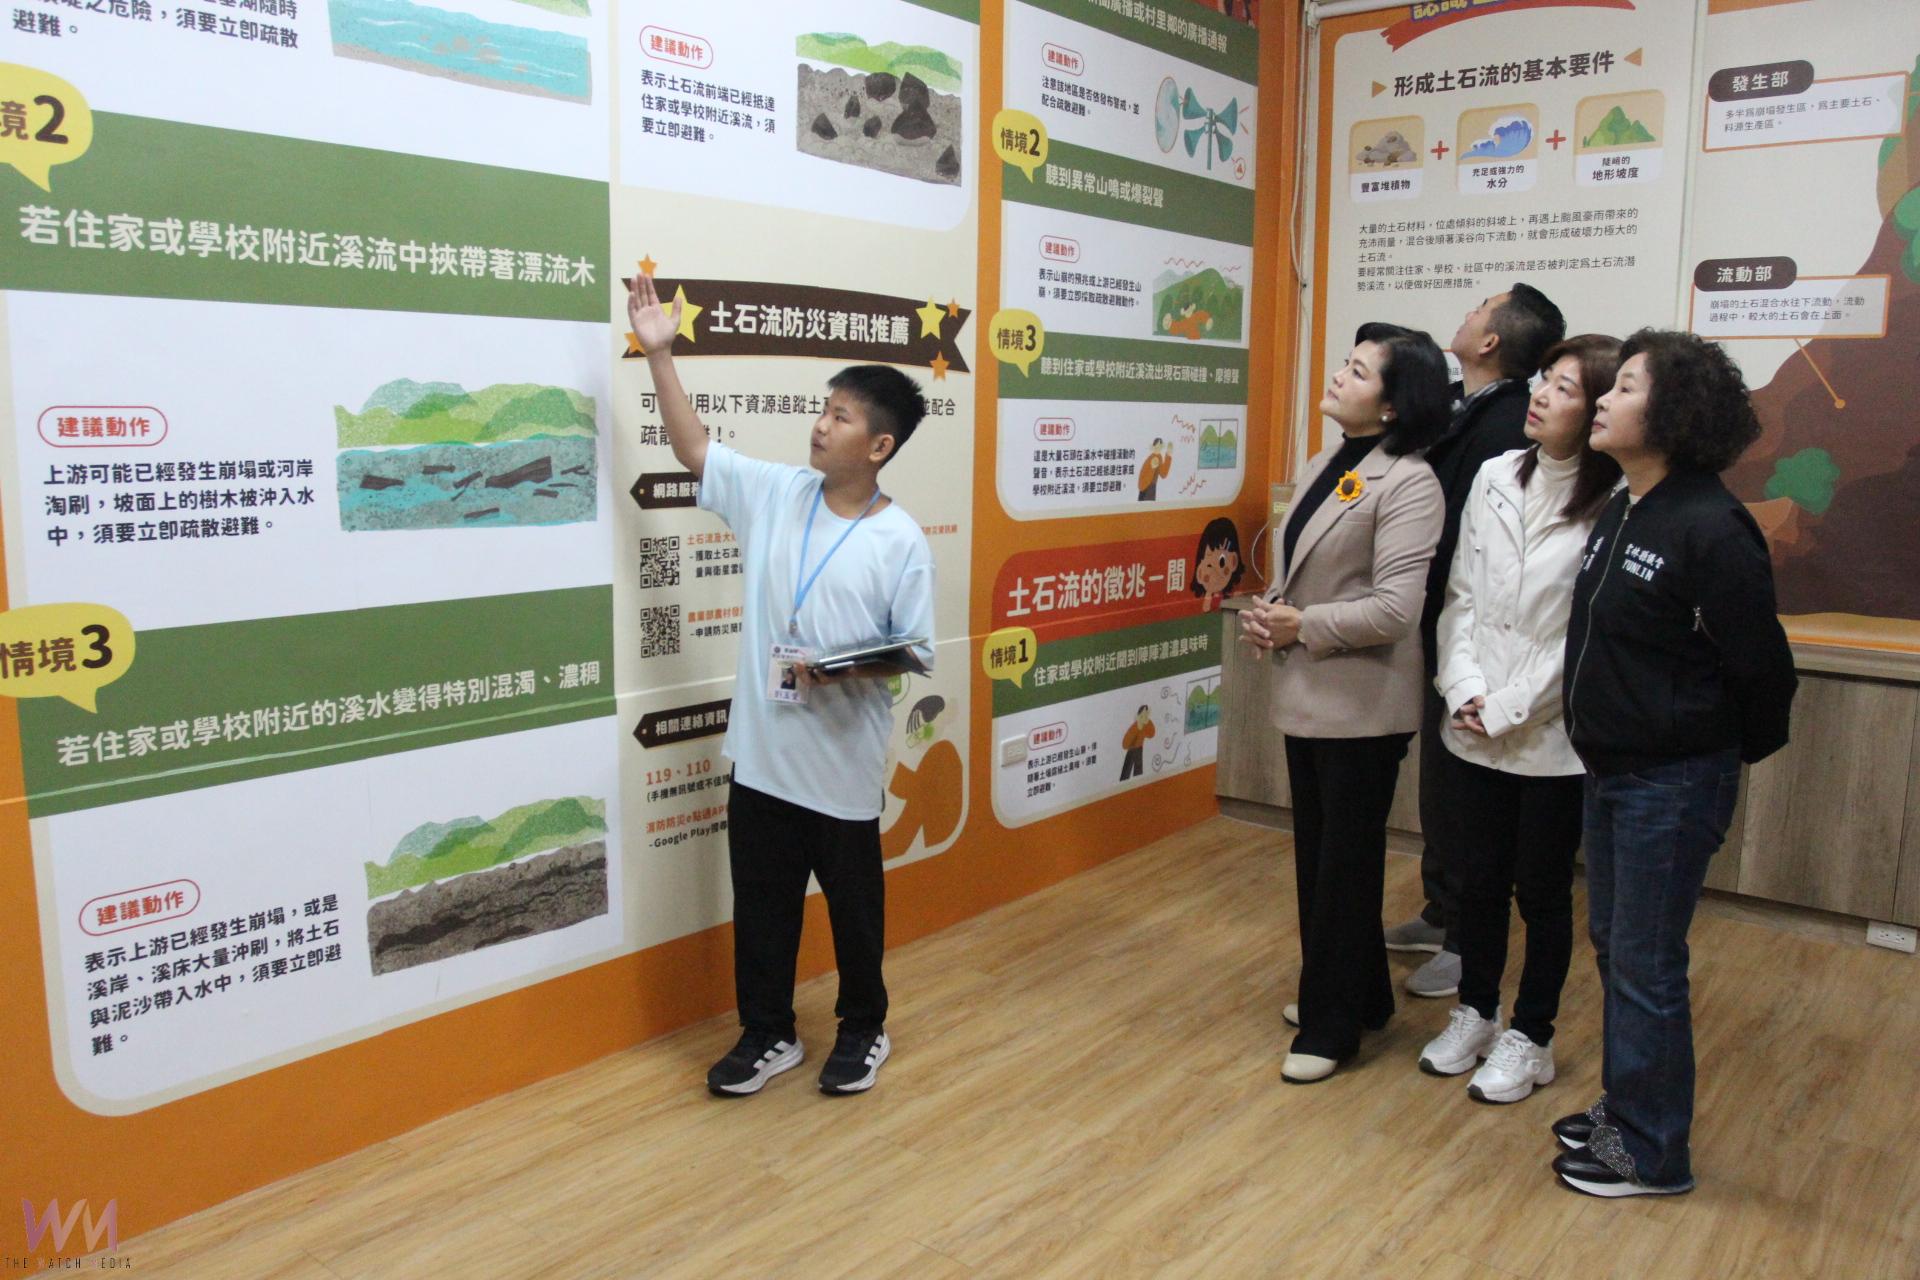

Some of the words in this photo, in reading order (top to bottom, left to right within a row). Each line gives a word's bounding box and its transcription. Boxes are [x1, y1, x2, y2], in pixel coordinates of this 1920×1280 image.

[13, 9, 78, 38] 避難。
[650, 34, 704, 62] 建議動作
[1047, 49, 1079, 70] 建議動作
[1394, 50, 1615, 97] 形成土石流的基本要件
[1732, 71, 1790, 93] 發生部
[641, 69, 776, 112] 表示土石流前端已經抵達
[641, 93, 776, 134] 住家或學校附近溪流，須
[1001, 128, 1041, 157] 情境2
[1472, 165, 1525, 177] 充足或強力的
[1592, 167, 1640, 181] 地形坡度
[1602, 156, 1631, 167] 陡峭的
[1046, 163, 1164, 208] 聽到異常山鳴或爆裂聲
[1361, 180, 1411, 193] 豐富堆積物
[1486, 177, 1507, 189] 水分
[19, 204, 597, 288] 若住家或學校附近溪流中挾帶著漂流木
[1045, 242, 1075, 257] 建議動作
[1358, 252, 1394, 263] 土石流。
[1717, 265, 1773, 284] 流動部
[709, 300, 910, 346] 土石流防災資訊推薦
[997, 325, 1037, 352] 情境3
[57, 416, 151, 438] 建議動作
[1040, 423, 1070, 436] 建議動作
[43, 459, 314, 485] 上游可能已經發生崩塌或河岸
[44, 486, 316, 516] 淘刷，坡面上的樹木被沖入水
[1006, 558, 1186, 617] 土石流的徵兆一聞
[0, 623, 113, 680] 情境3
[991, 638, 1029, 669] 情境1
[56, 660, 600, 767] 若住家或學校附近的溪水變得特別混濁、濃稠
[97, 890, 185, 926] 建議動作
[84, 893, 338, 974] 表示上游已經發生崩塌，或是
[87, 918, 340, 1001] 溪岸、溪床大量沖刷，將土石
[92, 1033, 129, 1057] 難。
